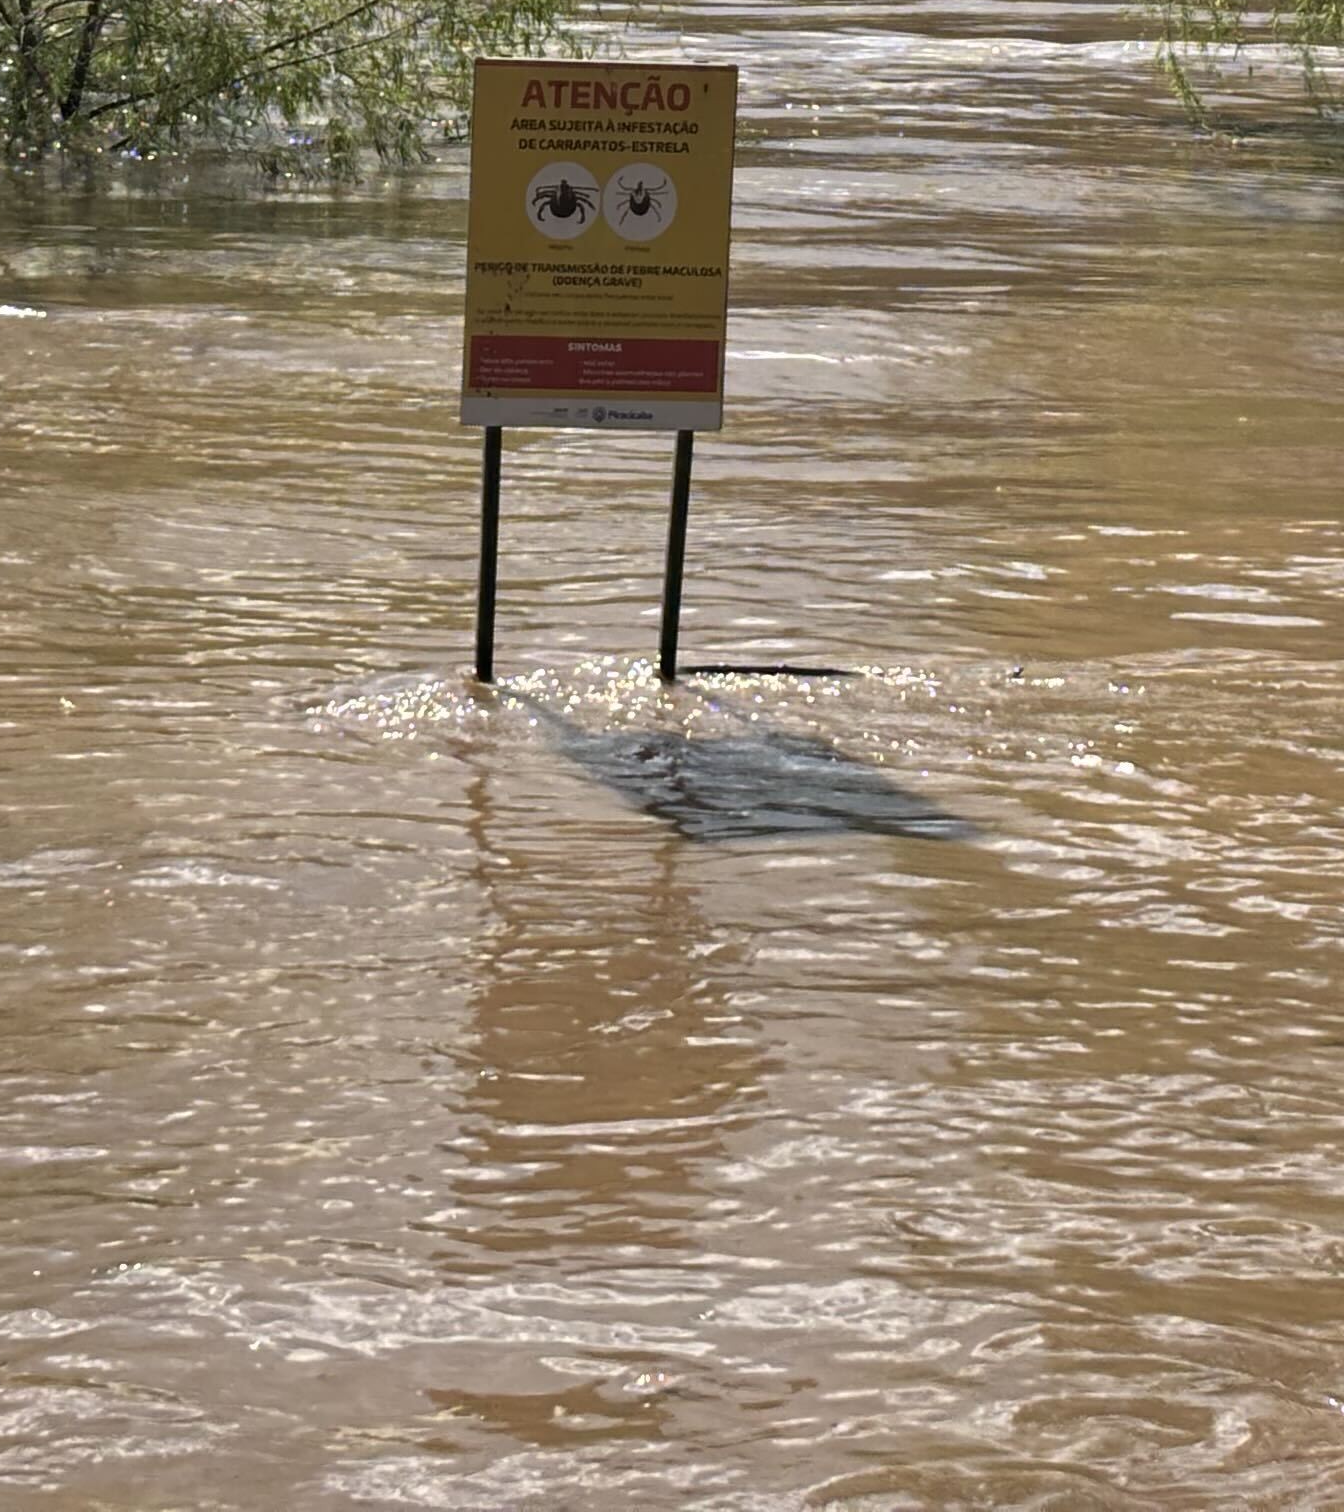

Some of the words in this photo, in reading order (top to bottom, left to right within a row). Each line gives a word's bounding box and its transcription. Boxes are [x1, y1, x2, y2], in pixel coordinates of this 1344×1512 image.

[521, 75, 691, 116] ATENÇÃO
[549, 119, 603, 132] SUJEITA
[616, 120, 699, 135] INFESTAÇÃO
[519, 138, 537, 149] DE
[539, 139, 690, 153] CARRAPATOS-ESTRELA
[474, 262, 512, 274] PERIGO
[514, 262, 528, 273] DE
[532, 263, 608, 274] TRANSMISSÃO
[610, 264, 624, 274] DE
[626, 265, 660, 276] FEBRE
[663, 265, 722, 277] MACULOSA
[552, 276, 599, 288] (DOENÇA
[601, 277, 642, 288] GRAVE)
[567, 343, 622, 353] SINTOMAS
